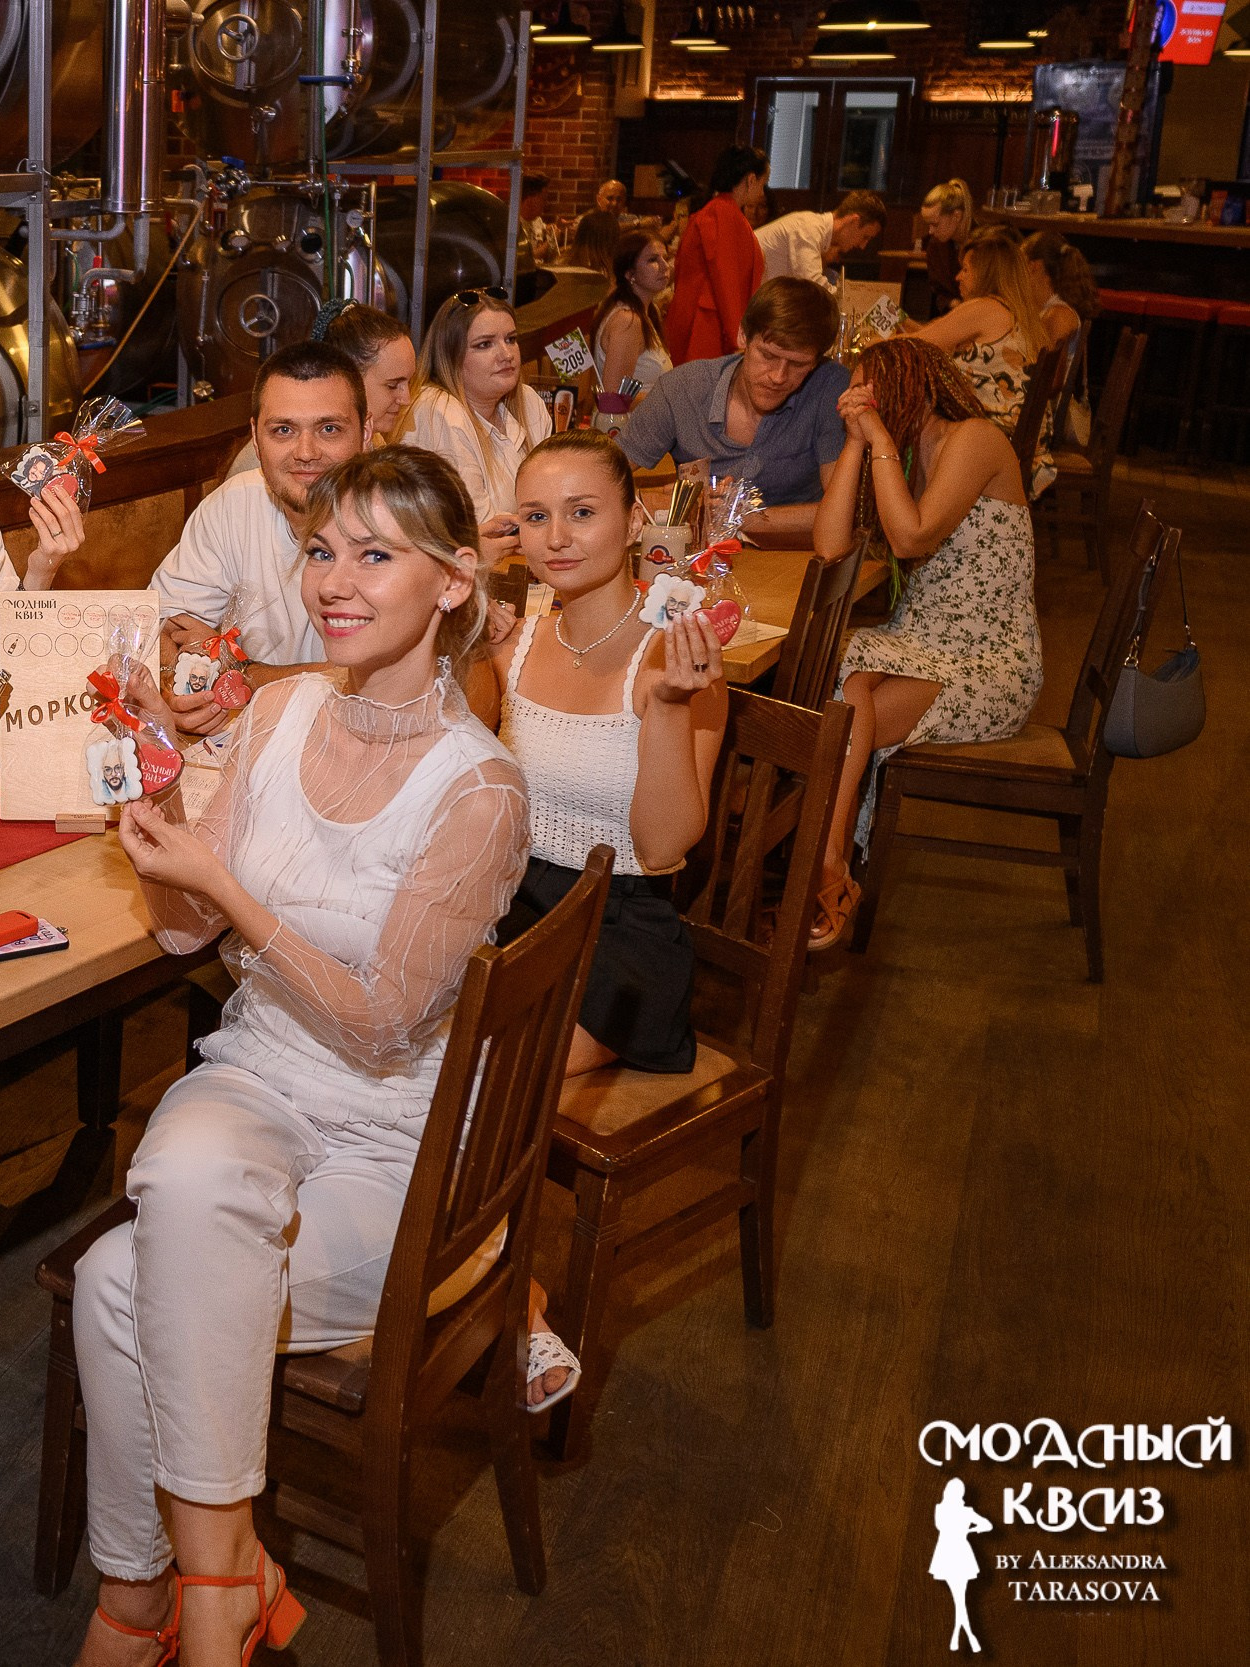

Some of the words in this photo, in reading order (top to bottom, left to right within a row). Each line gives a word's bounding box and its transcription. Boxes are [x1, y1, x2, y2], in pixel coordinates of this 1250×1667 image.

[562, 350, 585, 373] 209
[2, 598, 57, 610] МОДНЫЙ
[15, 611, 44, 620] КВИЗ
[142, 771, 162, 784] ВИЗ
